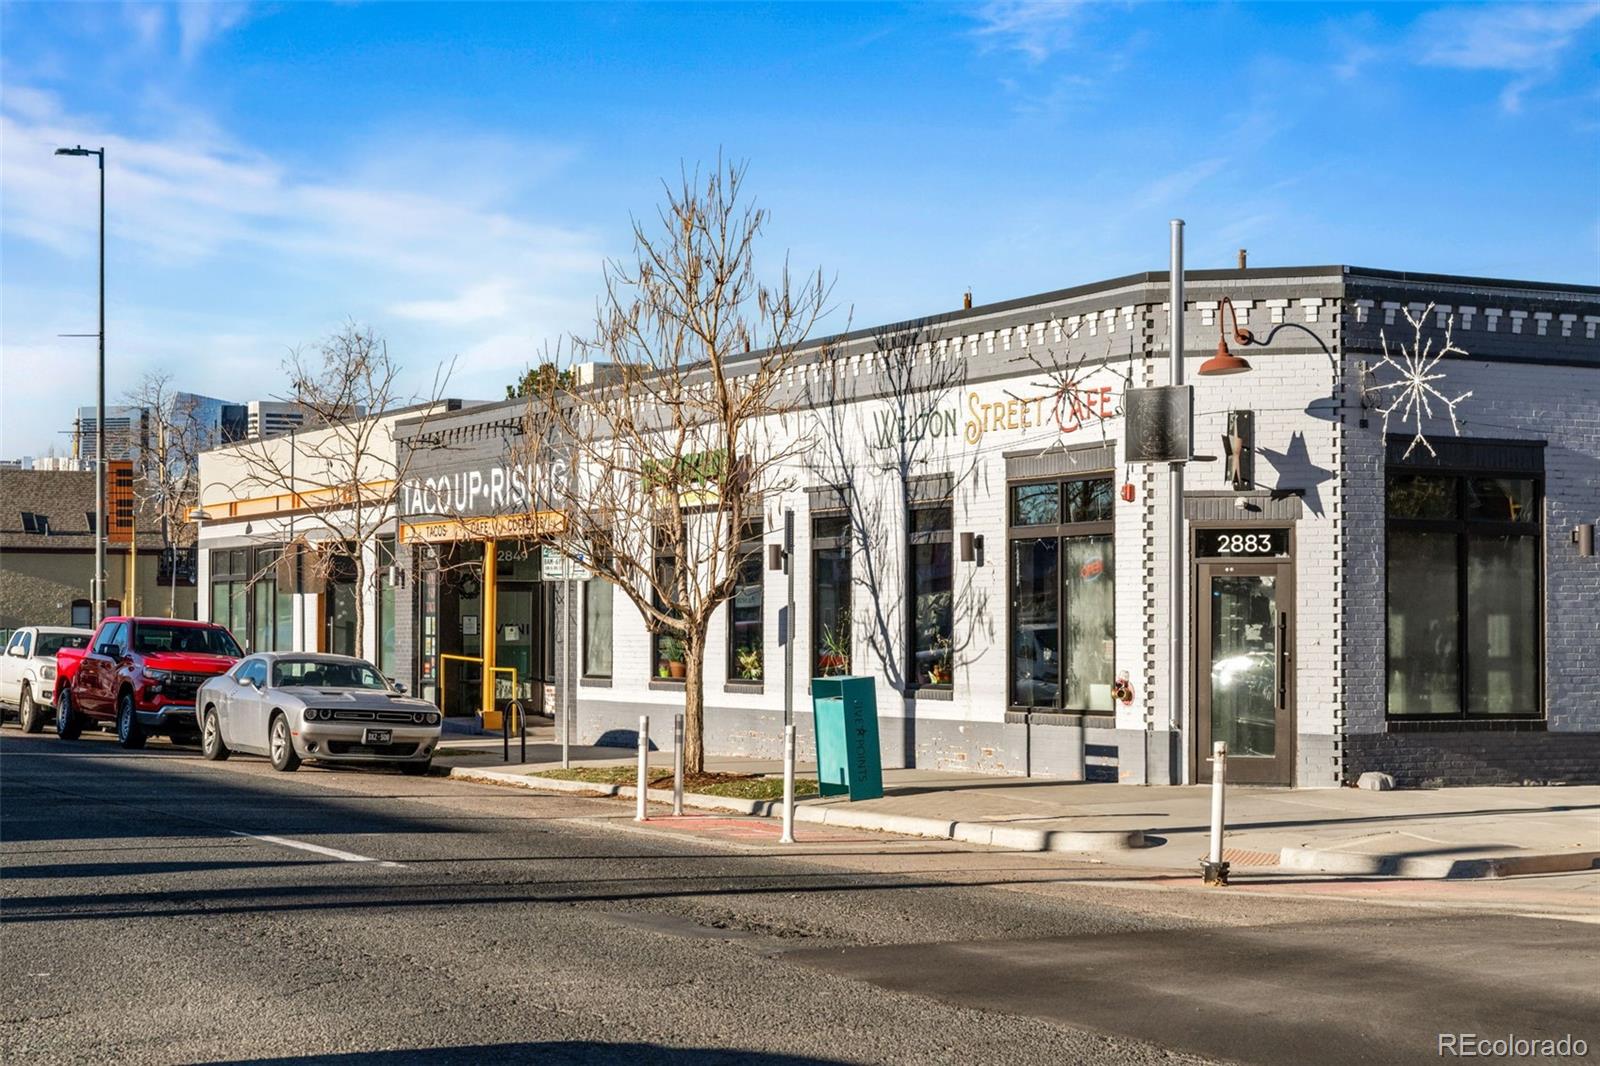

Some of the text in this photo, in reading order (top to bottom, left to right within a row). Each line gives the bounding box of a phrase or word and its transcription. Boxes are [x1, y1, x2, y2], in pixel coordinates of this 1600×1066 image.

[965, 391, 1043, 445] STREET
[426, 524, 447, 538] TACOS
[1217, 534, 1271, 553] 2883
[497, 550, 528, 562] 2849
